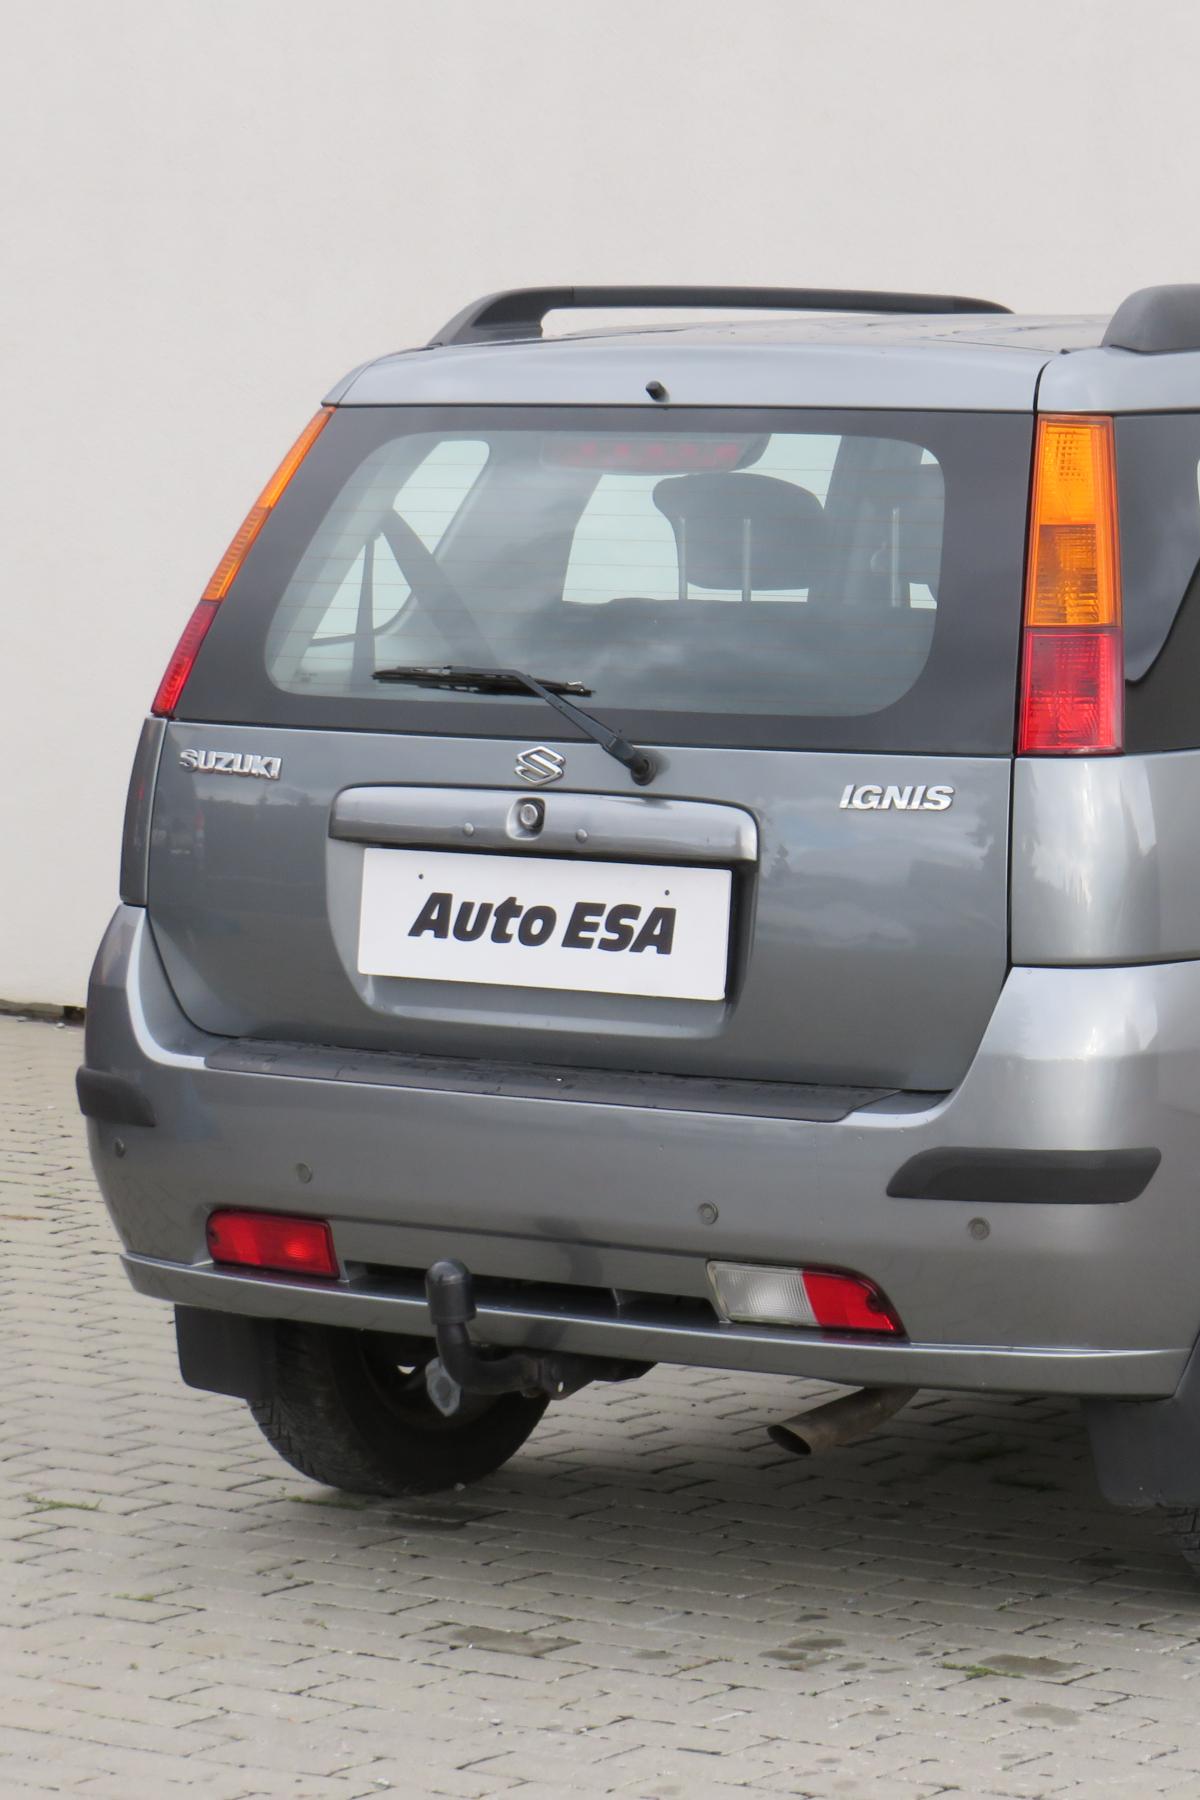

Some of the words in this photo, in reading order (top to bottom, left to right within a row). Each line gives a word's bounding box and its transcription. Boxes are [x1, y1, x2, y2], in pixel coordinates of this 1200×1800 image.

[179, 748, 282, 779] SUZUKI
[839, 784, 955, 811] IGNIS
[407, 891, 557, 946] Auto
[561, 901, 676, 955] ESA
